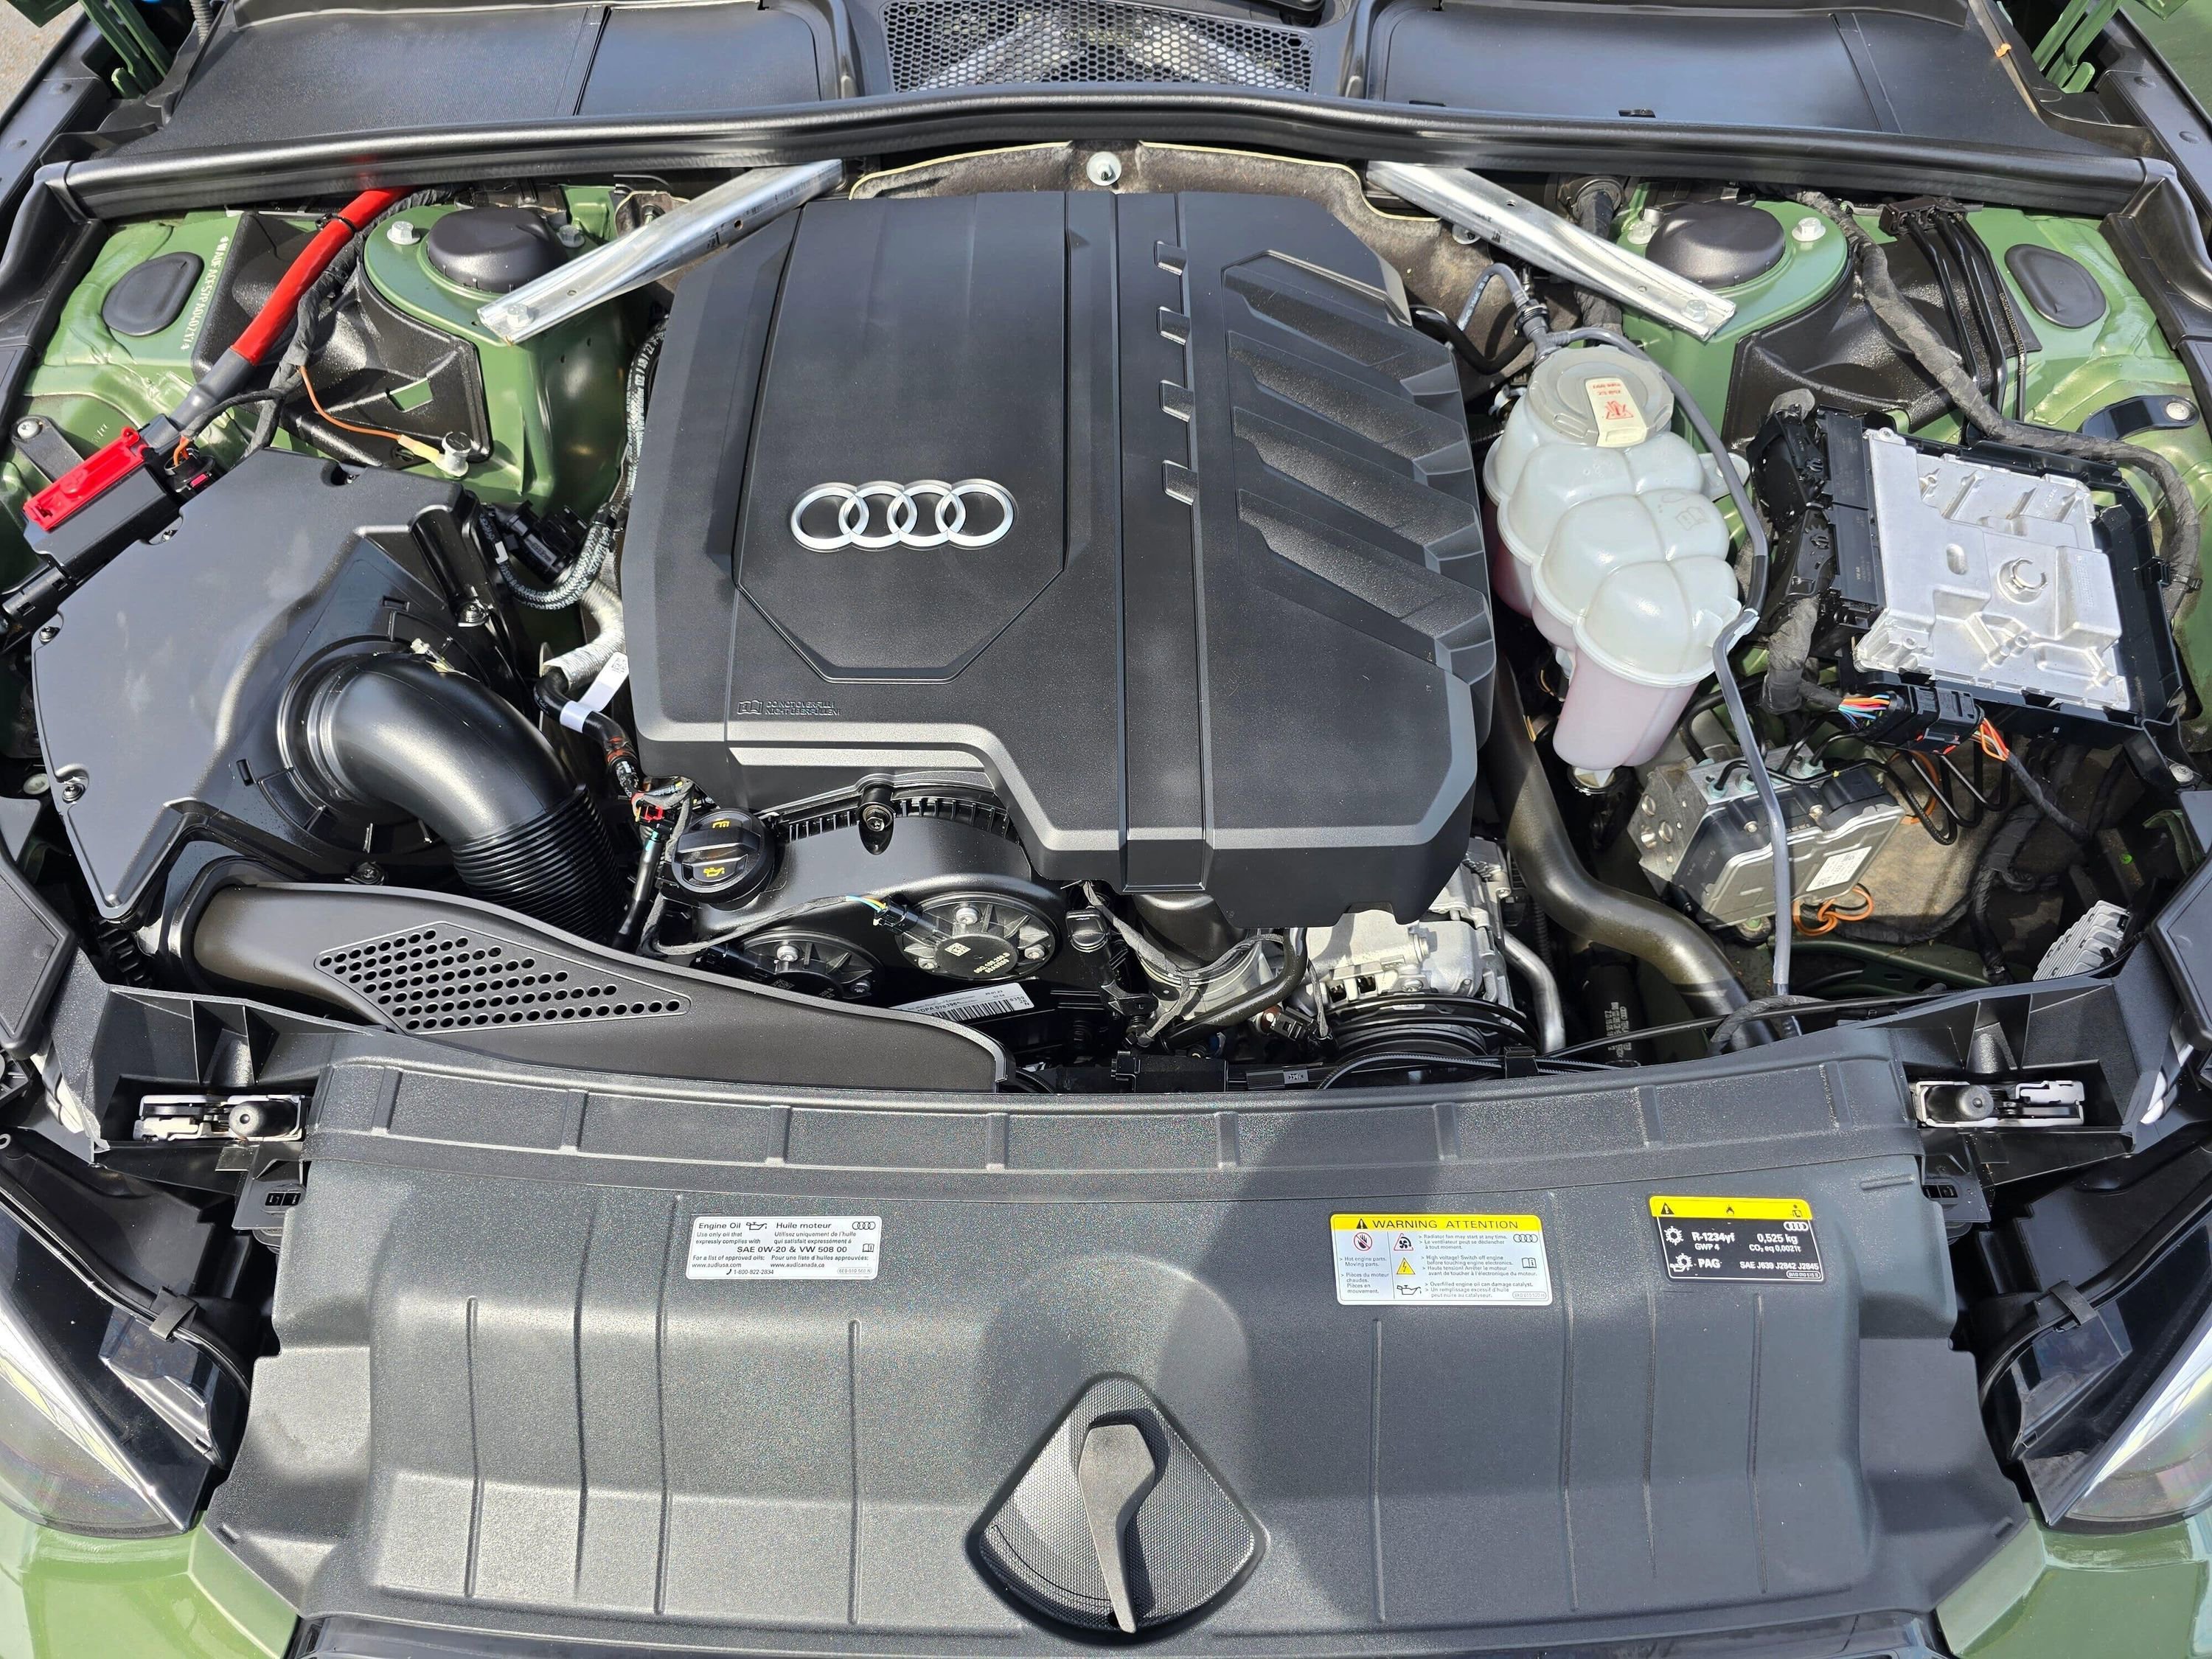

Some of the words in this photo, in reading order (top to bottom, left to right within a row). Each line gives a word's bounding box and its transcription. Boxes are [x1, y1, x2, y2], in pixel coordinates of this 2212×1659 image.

[1372, 1220, 1437, 1228] WARNING
[1446, 1220, 1518, 1229] ATTENTION
[1691, 1231, 1735, 1244] R-1234yf
[1757, 1233, 1784, 1244] 0,525
[1784, 1234, 1798, 1245] kg
[1697, 1258, 1720, 1268] PAG
